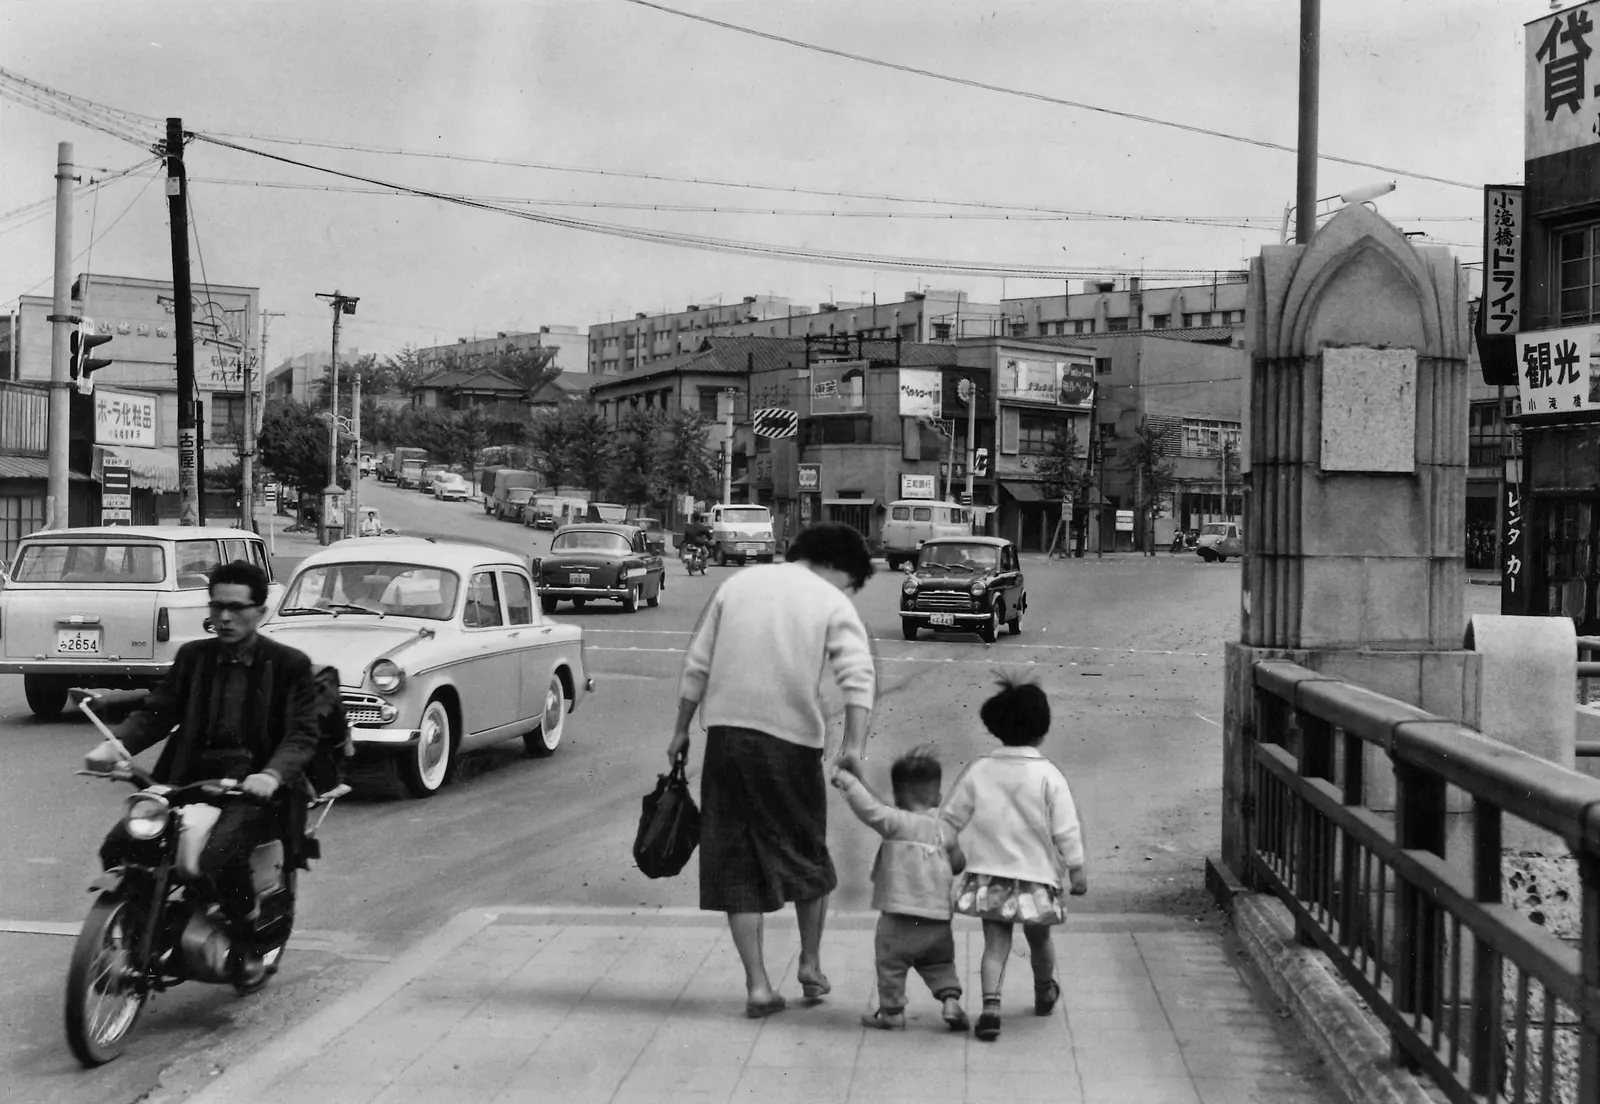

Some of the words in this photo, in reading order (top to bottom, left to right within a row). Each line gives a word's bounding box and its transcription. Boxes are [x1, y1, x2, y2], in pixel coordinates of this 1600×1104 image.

[1535, 9, 1600, 122] 貸
[1491, 191, 1518, 332] 小滝橋ドライブ
[1523, 339, 1581, 390] 観光
[1528, 394, 1583, 412] 小滝橋
[1506, 491, 1522, 593] レンタカー
